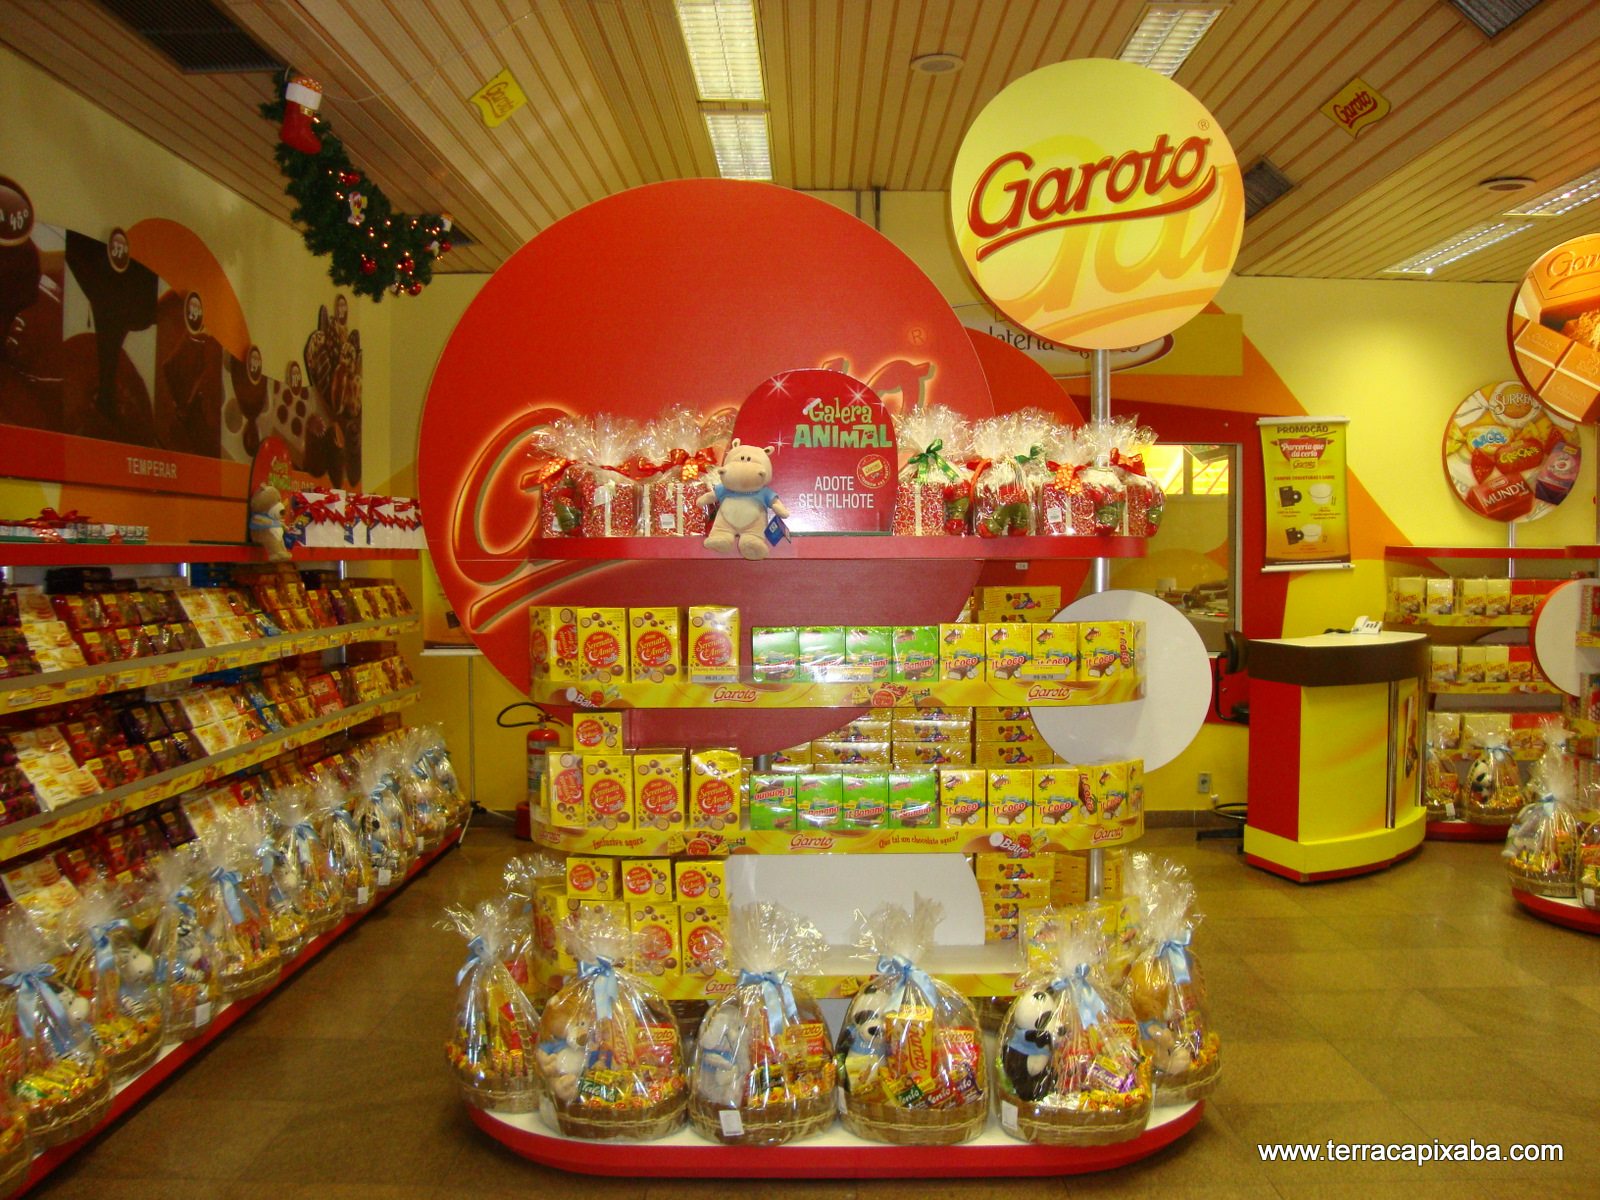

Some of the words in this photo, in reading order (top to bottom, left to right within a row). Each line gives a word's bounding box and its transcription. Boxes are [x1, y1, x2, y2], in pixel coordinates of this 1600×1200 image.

[1333, 90, 1379, 130] Garoto
[967, 133, 1217, 262] Garoto
[808, 397, 873, 425] Galera
[792, 424, 893, 448] ANIMAL
[1277, 424, 1329, 435] PROMOÇÃO
[126, 457, 178, 479] TEMPERAR
[814, 476, 855, 491] ADOTE
[798, 494, 822, 509] SEU
[825, 494, 874, 509] FILHOTE
[1482, 481, 1526, 507] MUNDY
[953, 656, 979, 668] Coco
[1001, 656, 1025, 667] Coco
[1093, 654, 1115, 665] Coco
[713, 685, 757, 703] Garoto
[1028, 684, 1072, 702] Garoto
[853, 805, 886, 819] Banana
[954, 802, 979, 814] Coco
[1001, 802, 1026, 813] Coco
[1047, 801, 1072, 813] Coco
[790, 833, 836, 850] Garoto
[892, 835, 900, 844] tal
[911, 836, 939, 845] chocolate
